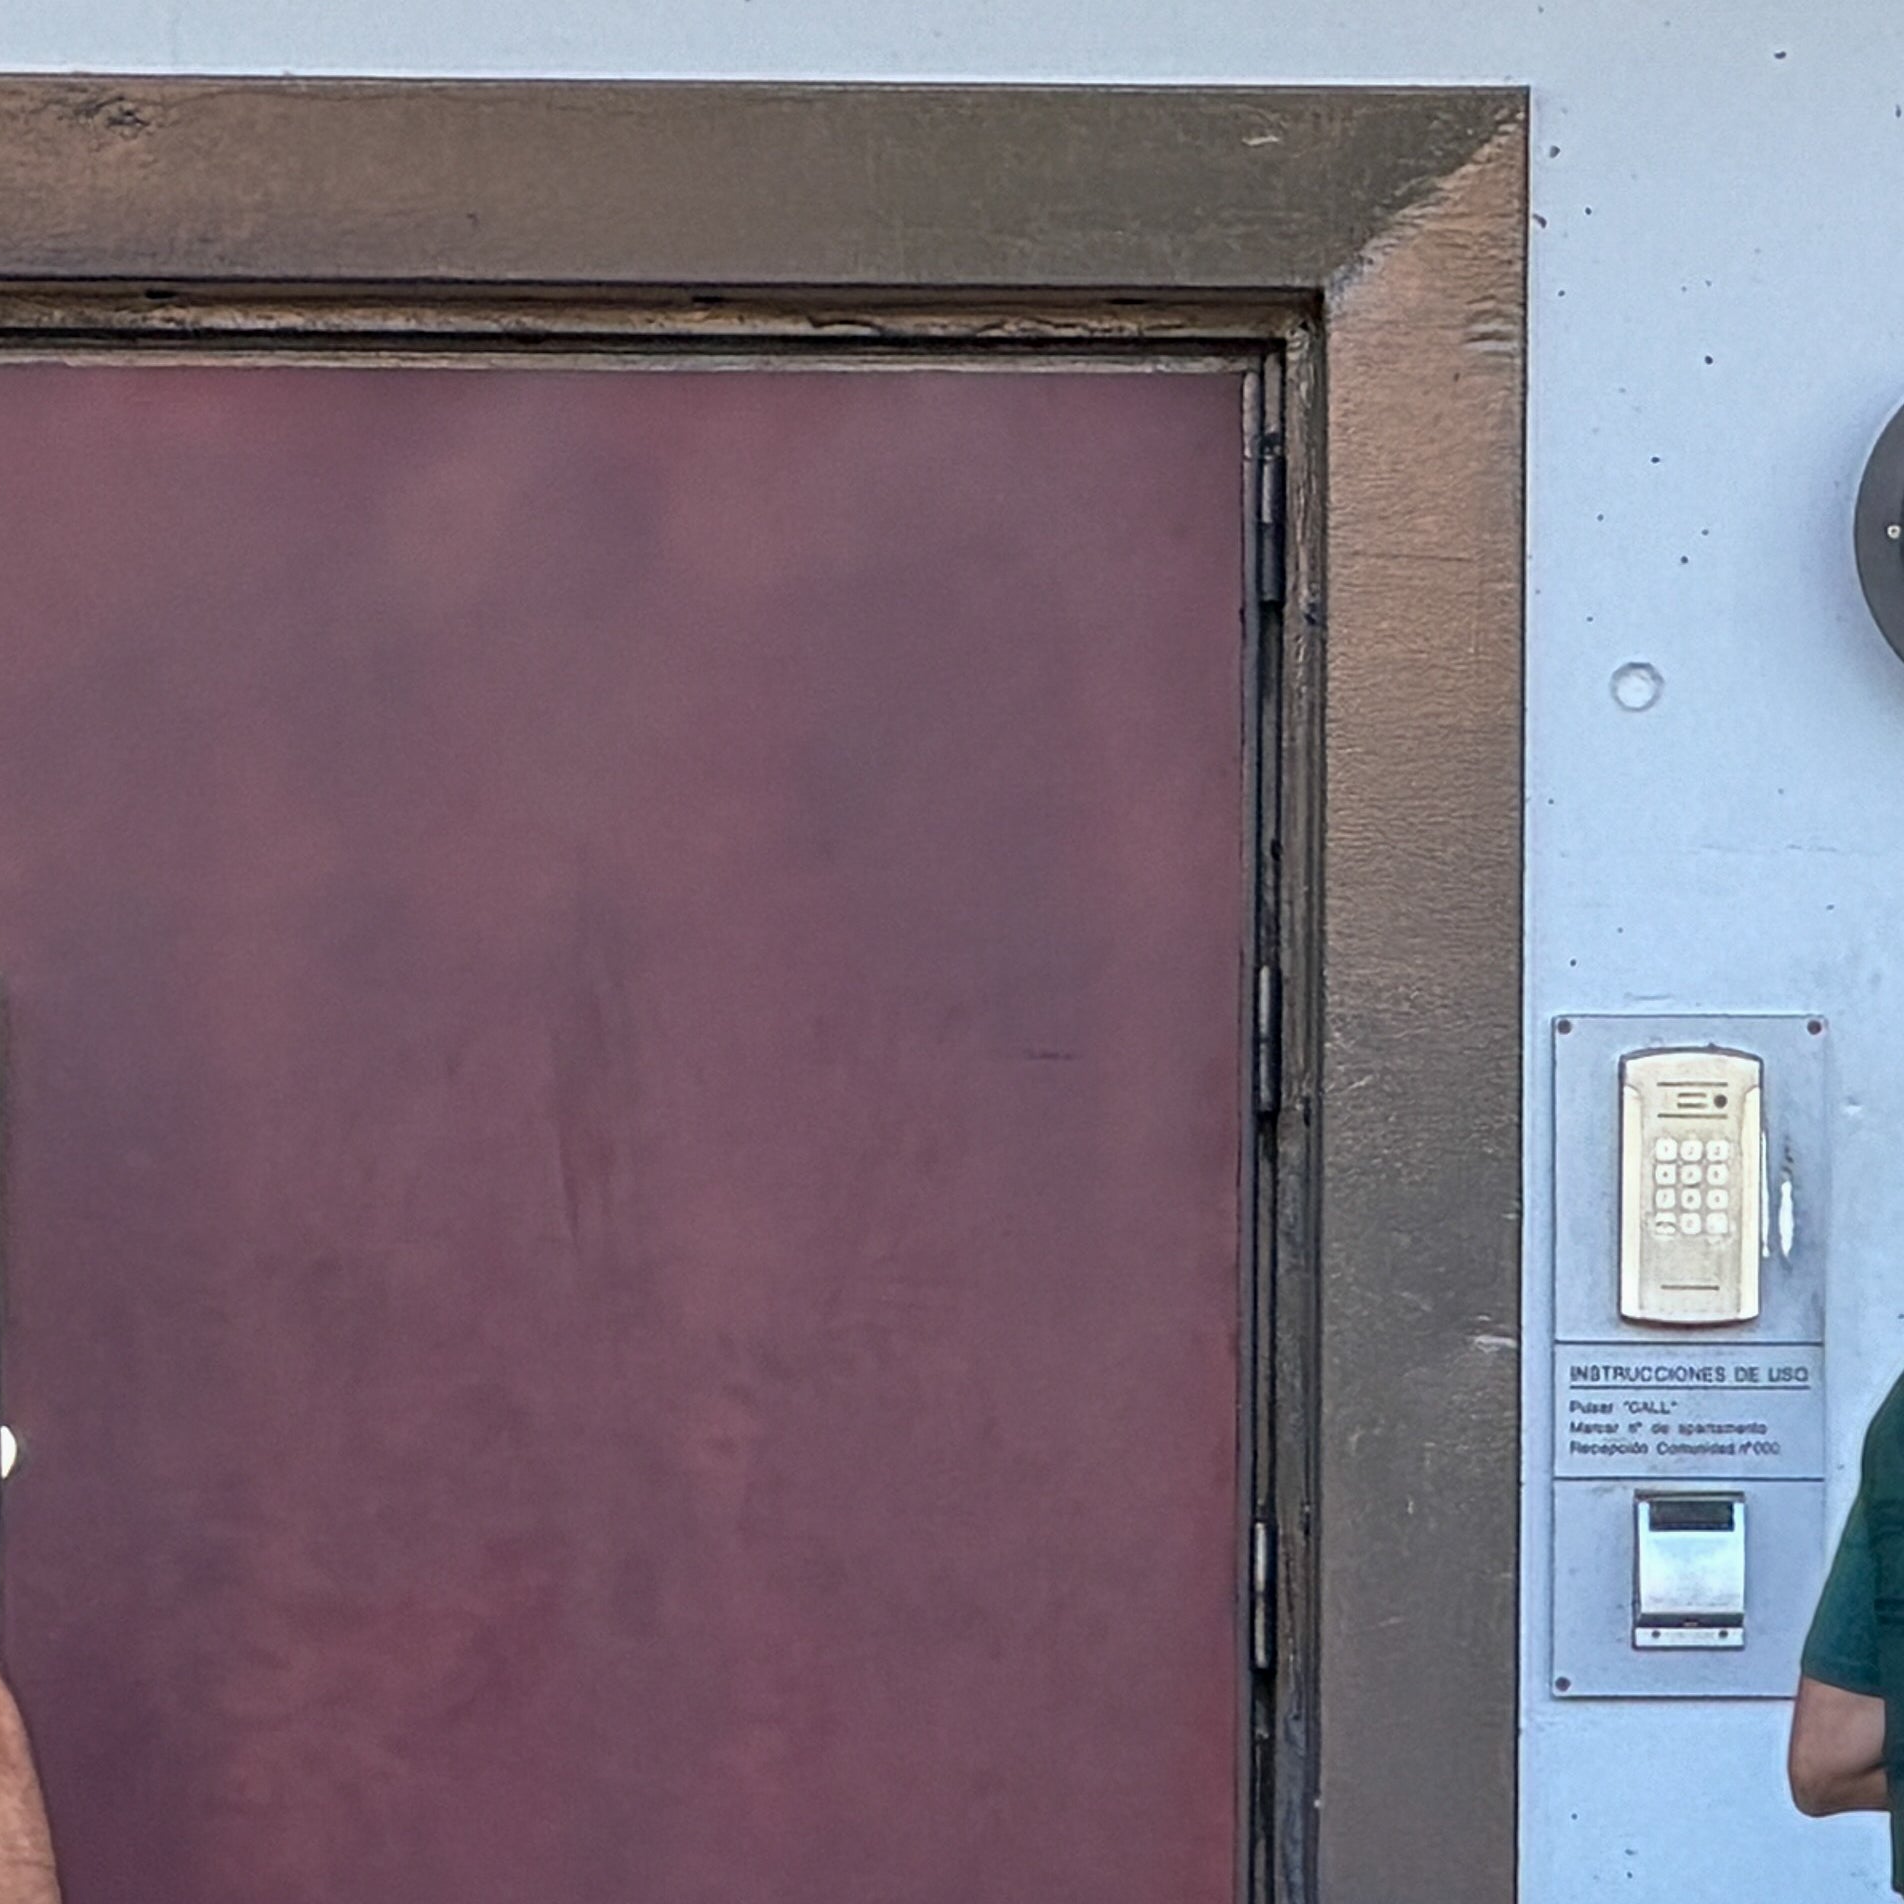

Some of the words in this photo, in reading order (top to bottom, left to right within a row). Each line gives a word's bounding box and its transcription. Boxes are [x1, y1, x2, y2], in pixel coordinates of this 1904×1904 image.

[1569, 1364, 1727, 1384] INSTRUCCIONES
[1734, 1366, 1760, 1383] DE
[1768, 1366, 1810, 1383] USO
[1569, 1399, 1614, 1414] Pulsar
[1569, 1421, 1619, 1435] Marcar
[1651, 1422, 1670, 1435] de
